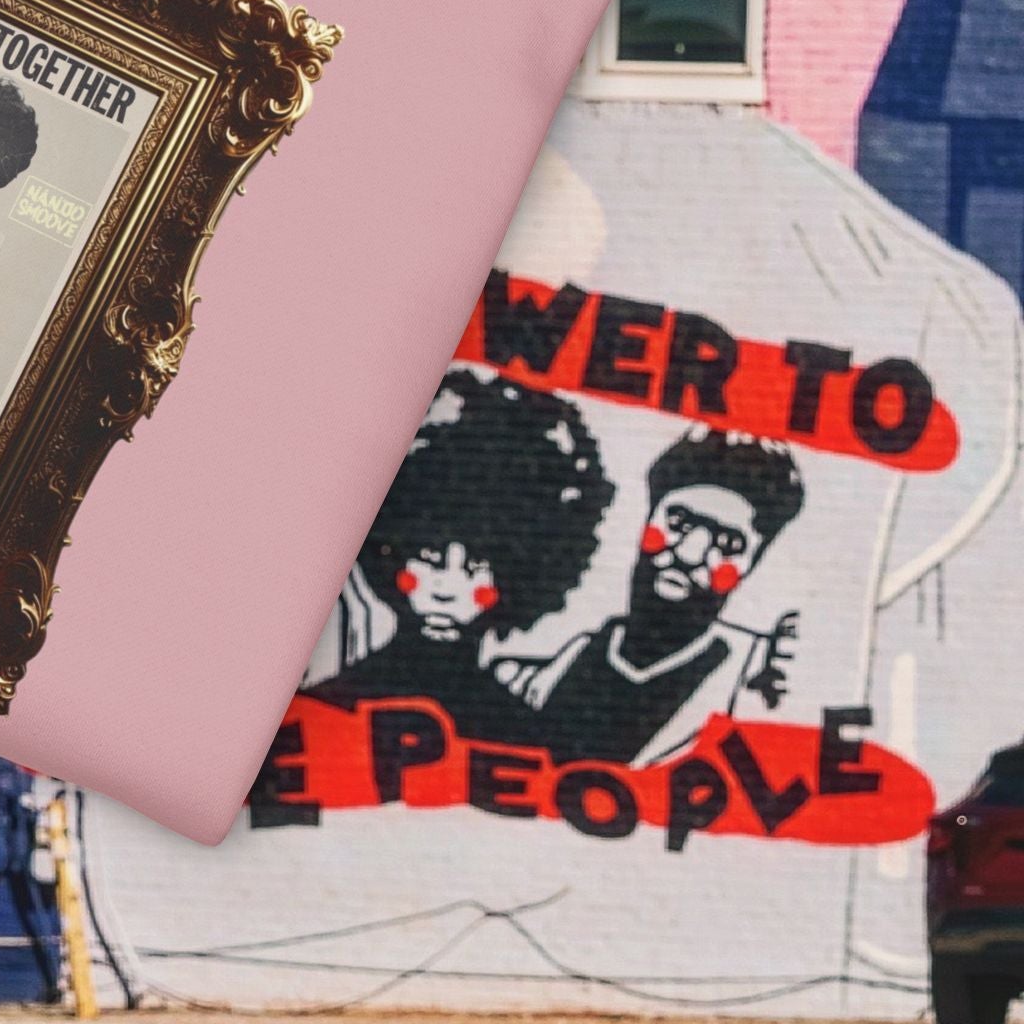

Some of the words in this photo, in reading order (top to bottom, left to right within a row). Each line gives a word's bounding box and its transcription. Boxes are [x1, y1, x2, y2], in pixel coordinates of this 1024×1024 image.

[17, 197, 78, 238] SMOOVE
[784, 340, 933, 454] TO
[370, 706, 883, 852] PEOPLE
